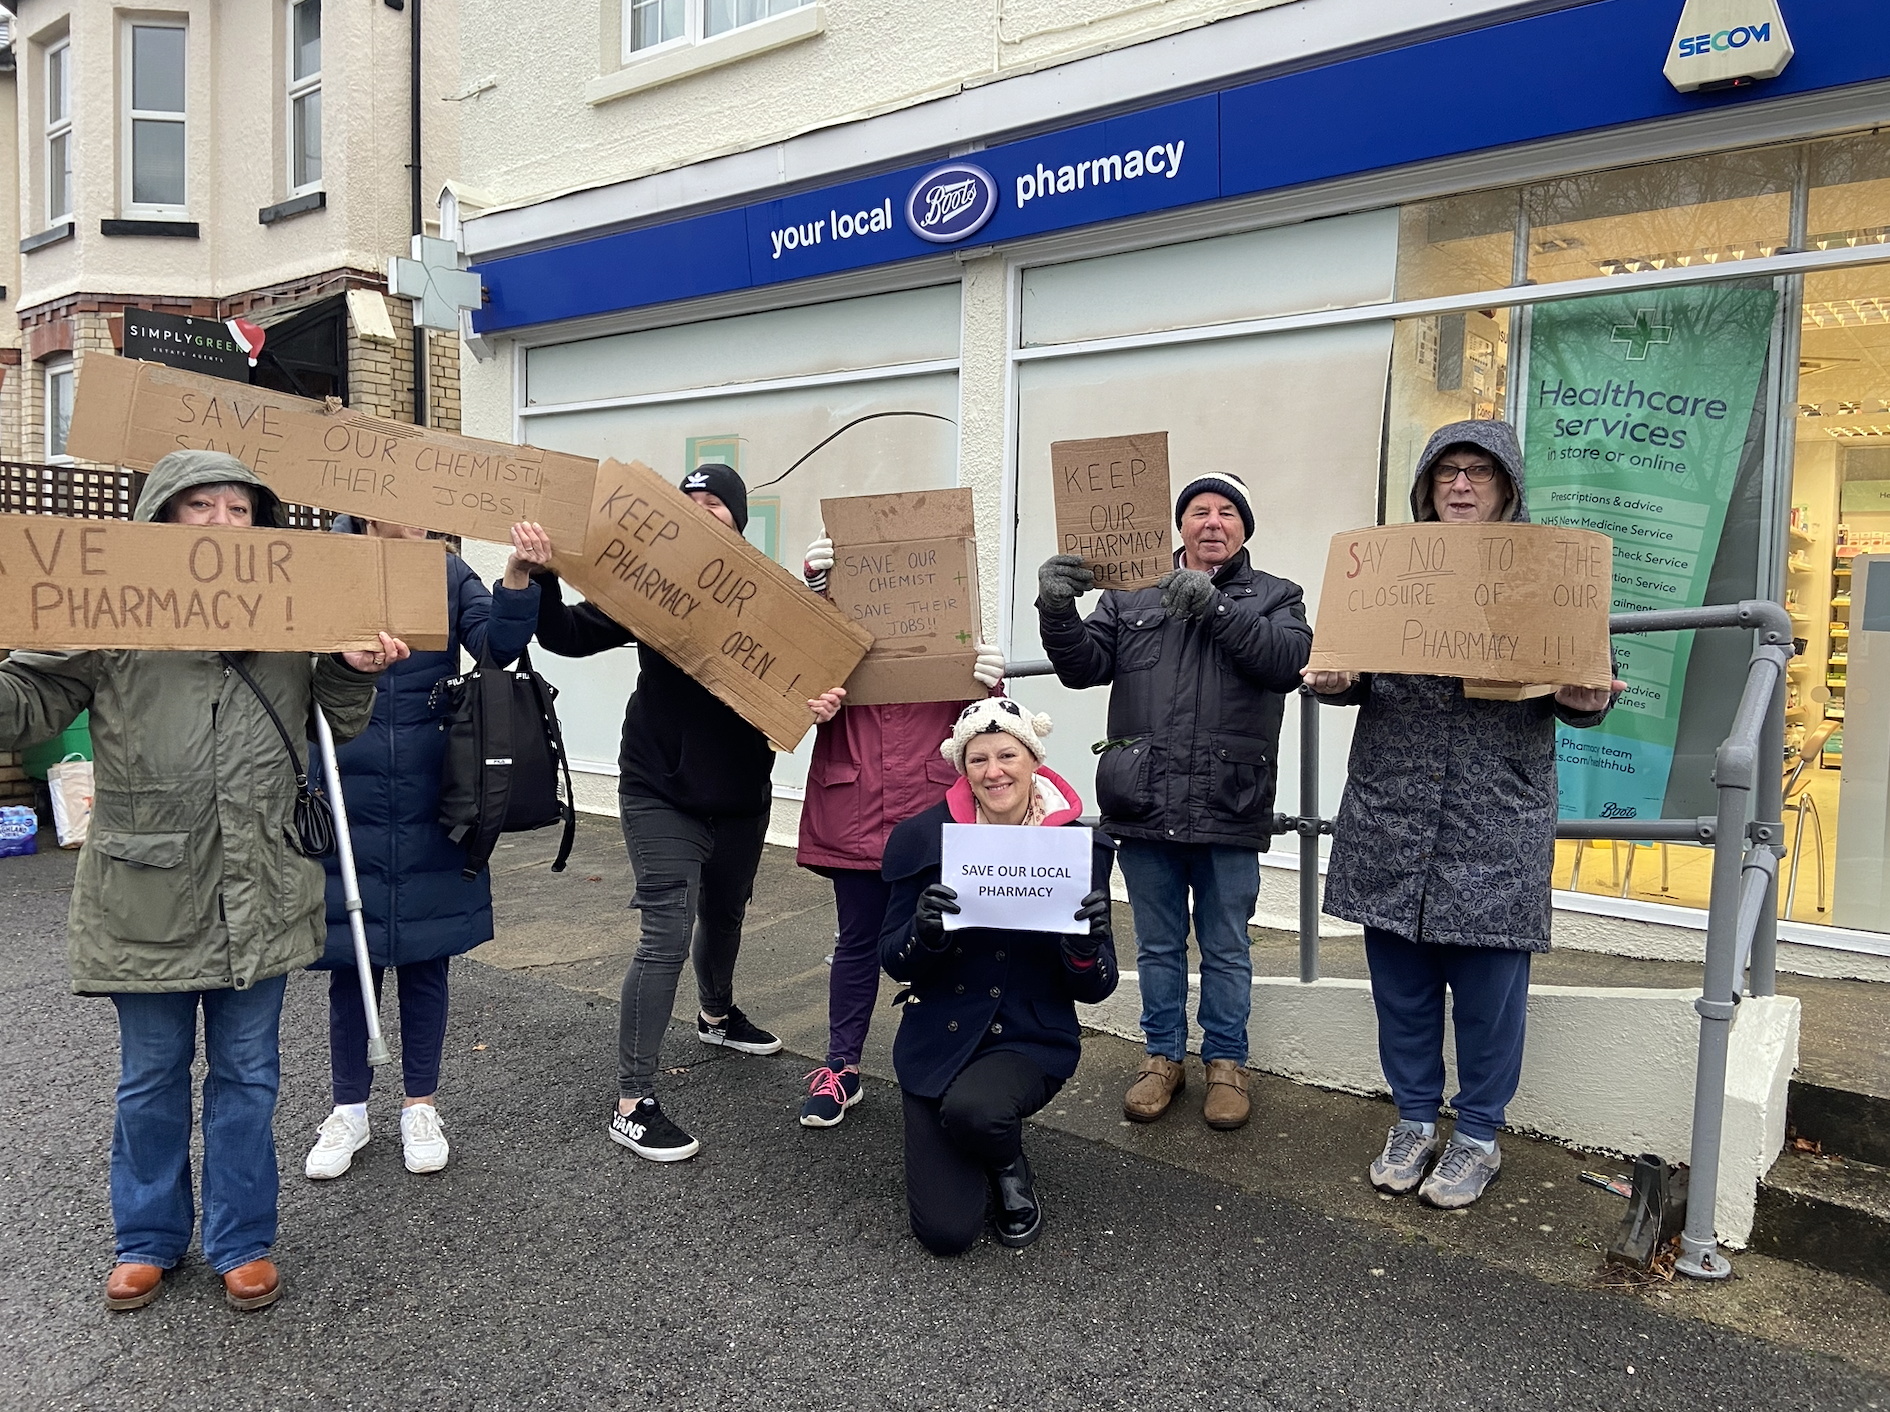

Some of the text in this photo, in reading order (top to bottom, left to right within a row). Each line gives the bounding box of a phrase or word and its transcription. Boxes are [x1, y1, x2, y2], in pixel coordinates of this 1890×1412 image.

[1678, 22, 1770, 58] SECOM
[770, 140, 1186, 259] your local Boots pharmacy
[152, 347, 224, 363] ESTATE AGENTS
[1539, 379, 1728, 420] Healthcare
[177, 393, 541, 486] SAVE OUR CHEMIST!
[1553, 413, 1688, 449] services
[1547, 447, 1687, 474] in store or online
[307, 459, 399, 499] THEIR
[1064, 458, 1147, 494] KEEP
[1551, 491, 1664, 513] Prescriptions & advice
[1089, 502, 1136, 533] OUR
[1541, 516, 1674, 541] NHS New Medicine Service
[600, 485, 758, 617] KEEP OUR
[1064, 530, 1165, 559] PHARMACY
[1346, 537, 1601, 579] SAY NO TO THE
[1612, 546, 1688, 570] Check Service
[189, 536, 293, 584] OUR
[844, 549, 937, 578] SAVE OUR
[1093, 558, 1144, 583] OPEN
[869, 573, 936, 593] CHEMIST
[1348, 583, 1598, 612] CLOSURE OF OUR
[1612, 573, 1677, 593] tion Service
[31, 581, 263, 630] PHARMACY
[594, 538, 702, 621] PHARMACY
[721, 631, 777, 680] OPEN
[853, 598, 958, 620] SAVE THEIR
[1402, 619, 1519, 662] PHARMACY
[446, 676, 465, 688] FILA
[1624, 685, 1661, 700] advice
[1617, 695, 1646, 709] cines
[1601, 746, 1632, 760] team
[1598, 801, 1638, 819] Boots
[961, 864, 1072, 879] SAVE OUR LOCAL
[978, 886, 1054, 898] PHARMACY
[612, 1110, 648, 1141] VANS
